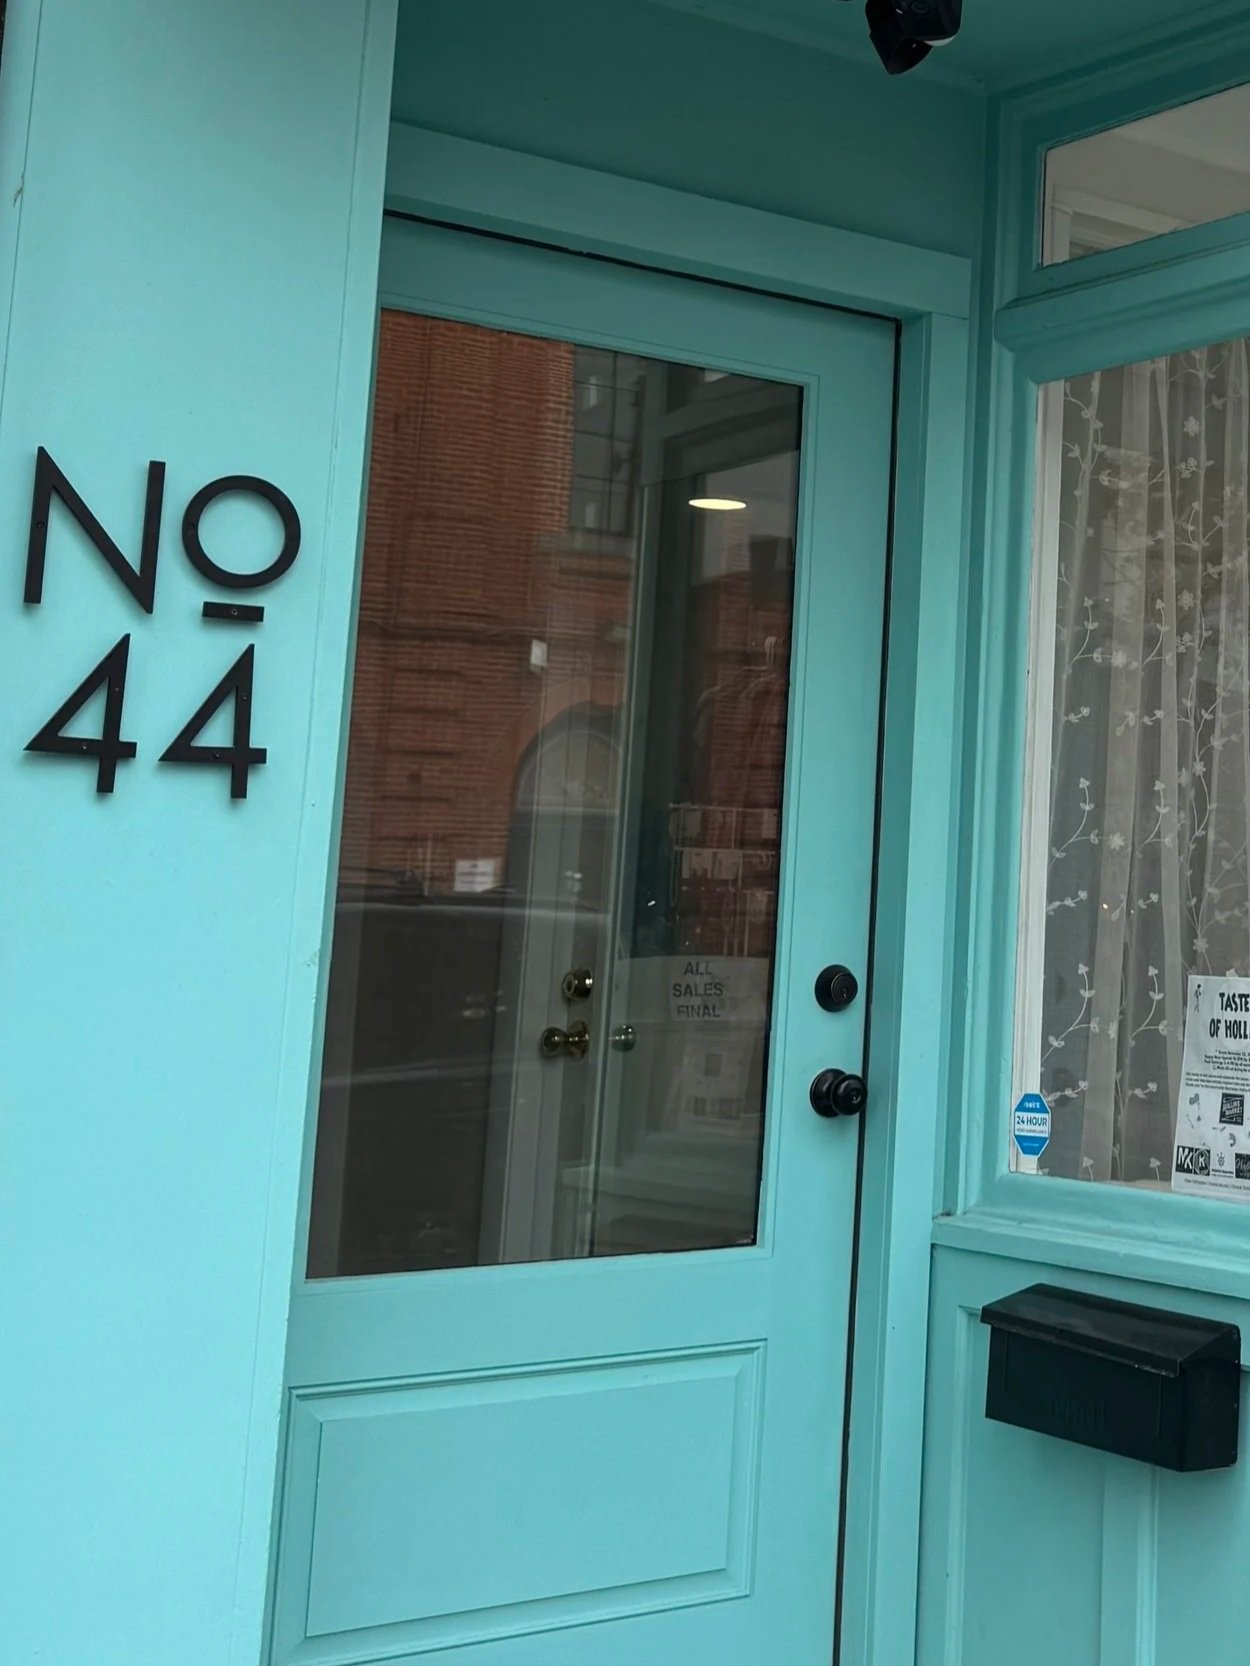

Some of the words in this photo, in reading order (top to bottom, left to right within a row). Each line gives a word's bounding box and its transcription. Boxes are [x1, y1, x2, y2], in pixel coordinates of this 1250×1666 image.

[23, 632, 268, 799] 44
[683, 961, 714, 976] ALL
[672, 983, 725, 998] SALES
[1219, 992, 1250, 1013] TASTE
[676, 1004, 721, 1018] FINAL
[1209, 1018, 1221, 1038] OF
[1016, 1115, 1025, 1126] 24
[1026, 1115, 1048, 1128] HOUR
